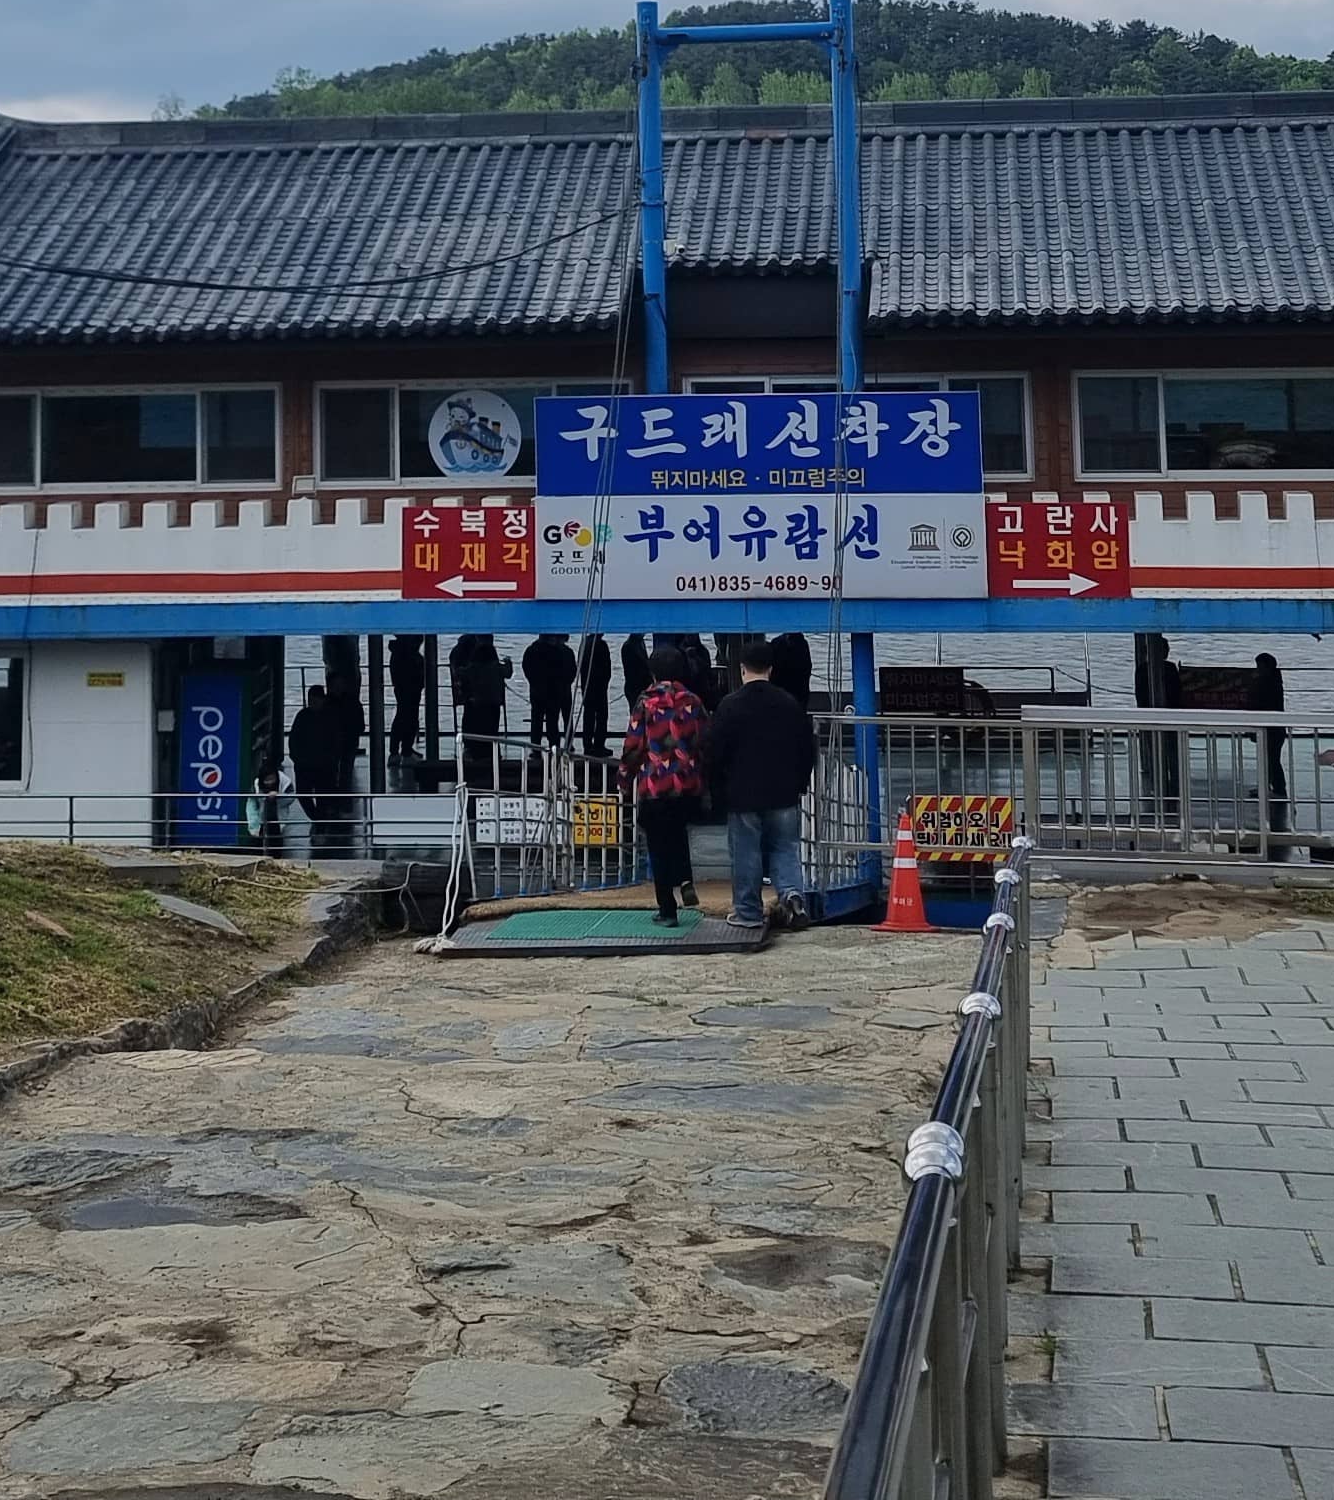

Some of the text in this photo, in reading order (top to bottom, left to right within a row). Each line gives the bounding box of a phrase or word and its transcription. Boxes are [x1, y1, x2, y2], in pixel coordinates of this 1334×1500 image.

[558, 399, 962, 462] 구드래선착장
[651, 469, 747, 490] 뛰지마세요
[413, 509, 528, 539] 수북정
[623, 504, 881, 562] 부여유람선
[997, 506, 1119, 535] 고란사
[414, 543, 530, 572] 대재각
[998, 540, 1119, 570] 낙화암
[190, 706, 228, 820] pepsi
